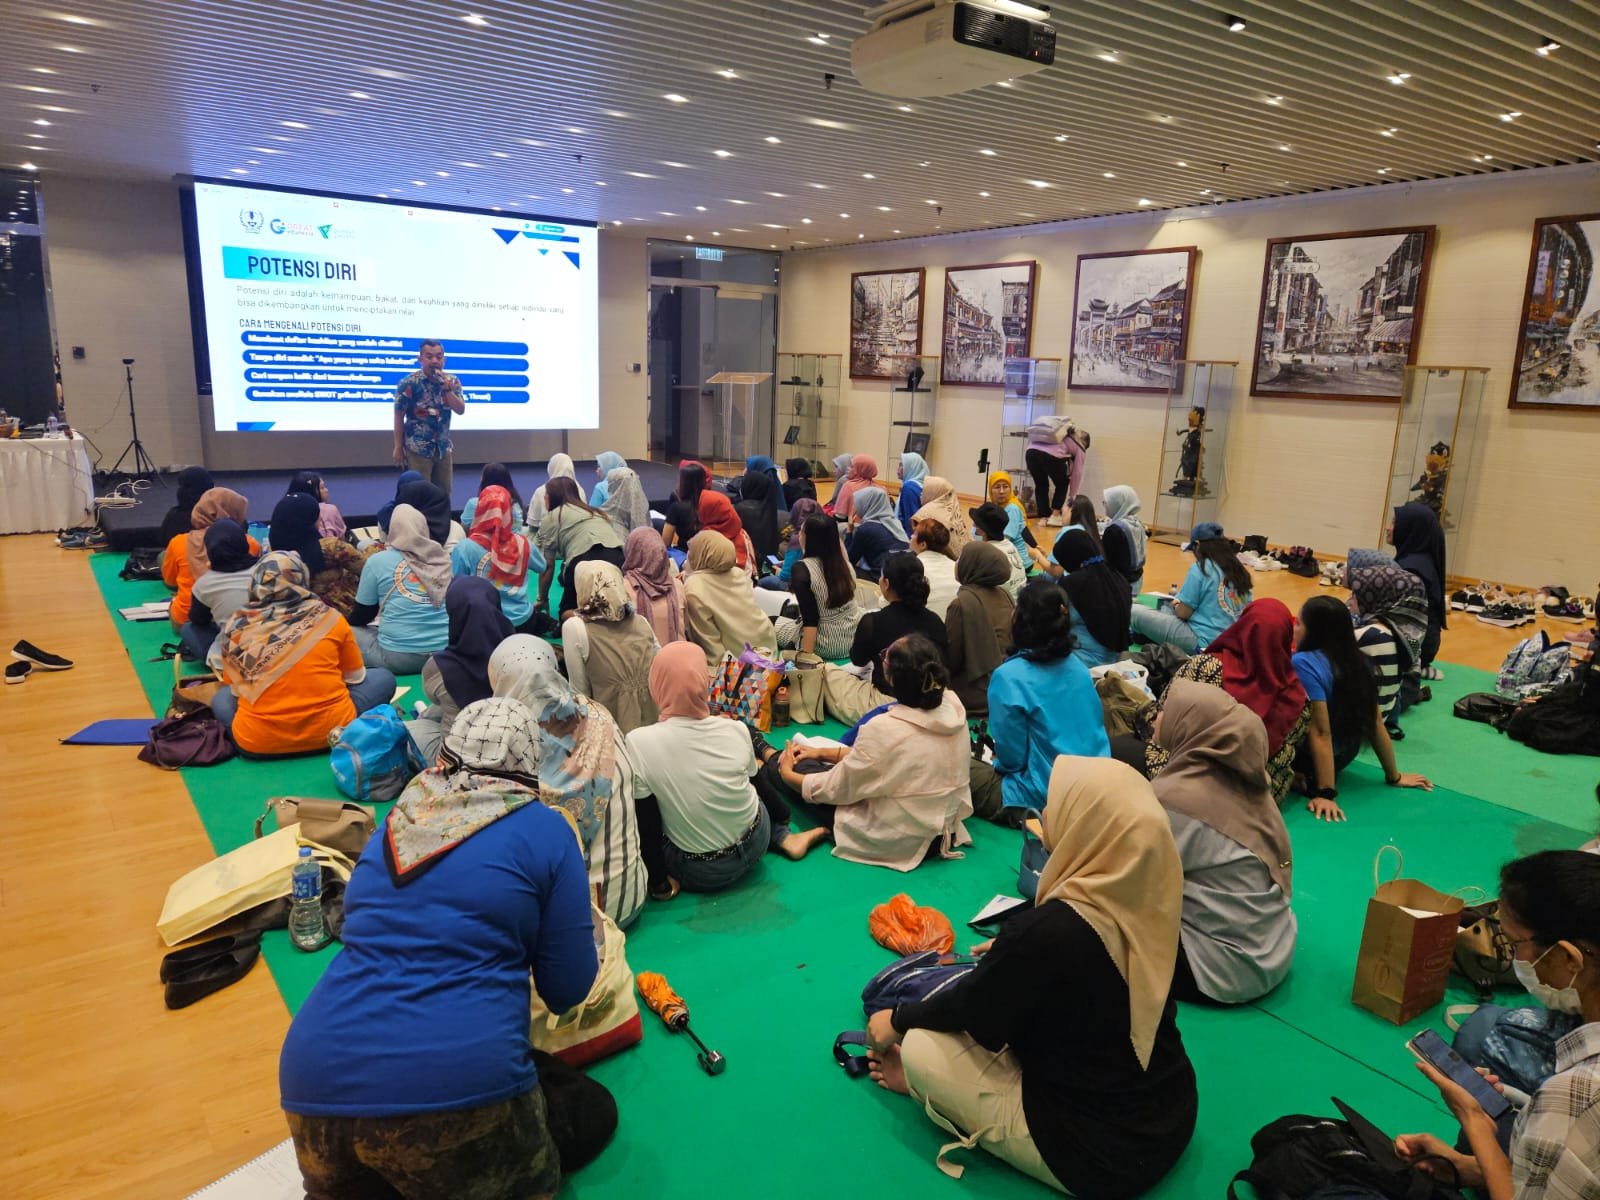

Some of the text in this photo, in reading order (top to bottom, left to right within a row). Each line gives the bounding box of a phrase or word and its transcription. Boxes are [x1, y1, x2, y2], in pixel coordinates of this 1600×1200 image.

[248, 255, 357, 281] POTENSI DIRI
[236, 285, 270, 295] Potensi
[273, 287, 287, 296] diri
[290, 288, 318, 298] adalah
[402, 296, 416, 305] dan
[237, 298, 256, 307] bisa
[258, 300, 320, 311] dikembangkan
[322, 302, 345, 312] untuk
[239, 319, 362, 333] CARA MENGENALI POTENSI DIRI
